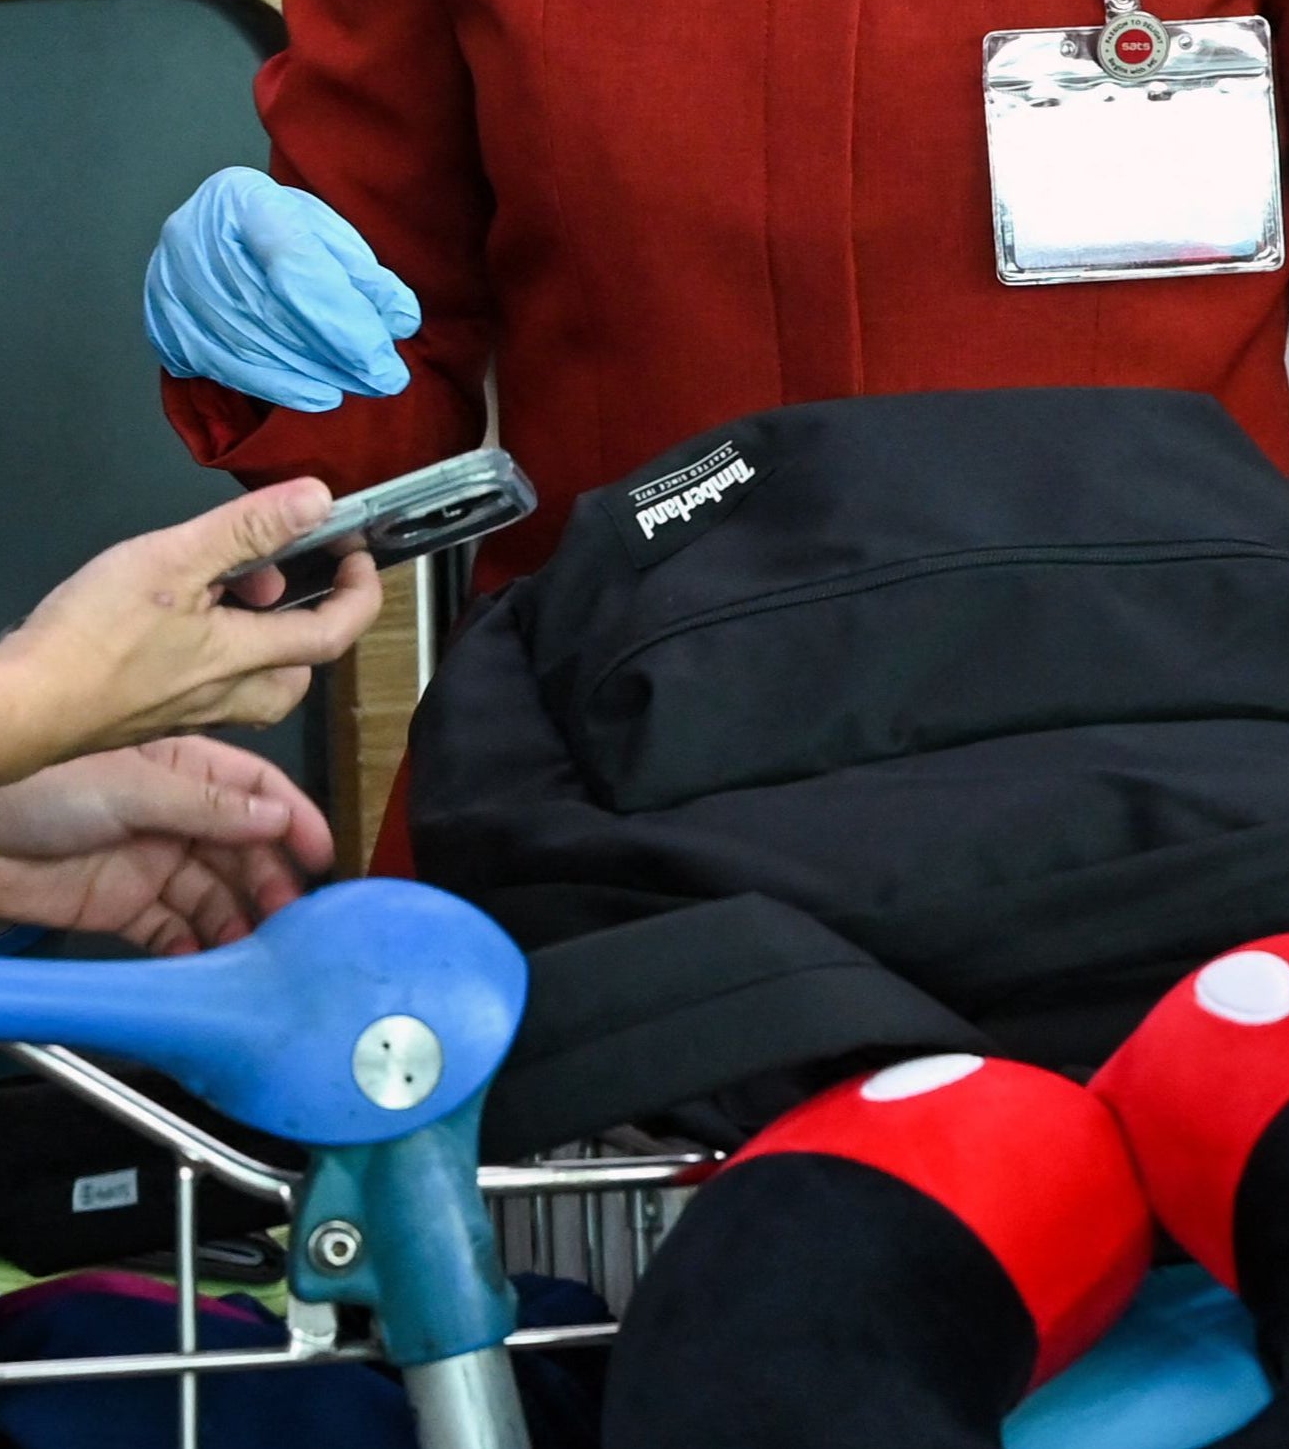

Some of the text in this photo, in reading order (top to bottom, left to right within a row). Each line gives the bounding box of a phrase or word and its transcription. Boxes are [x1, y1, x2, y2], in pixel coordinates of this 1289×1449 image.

[635, 446, 733, 502] CRAFTED SINCE 1973
[635, 457, 756, 540] Timberland
